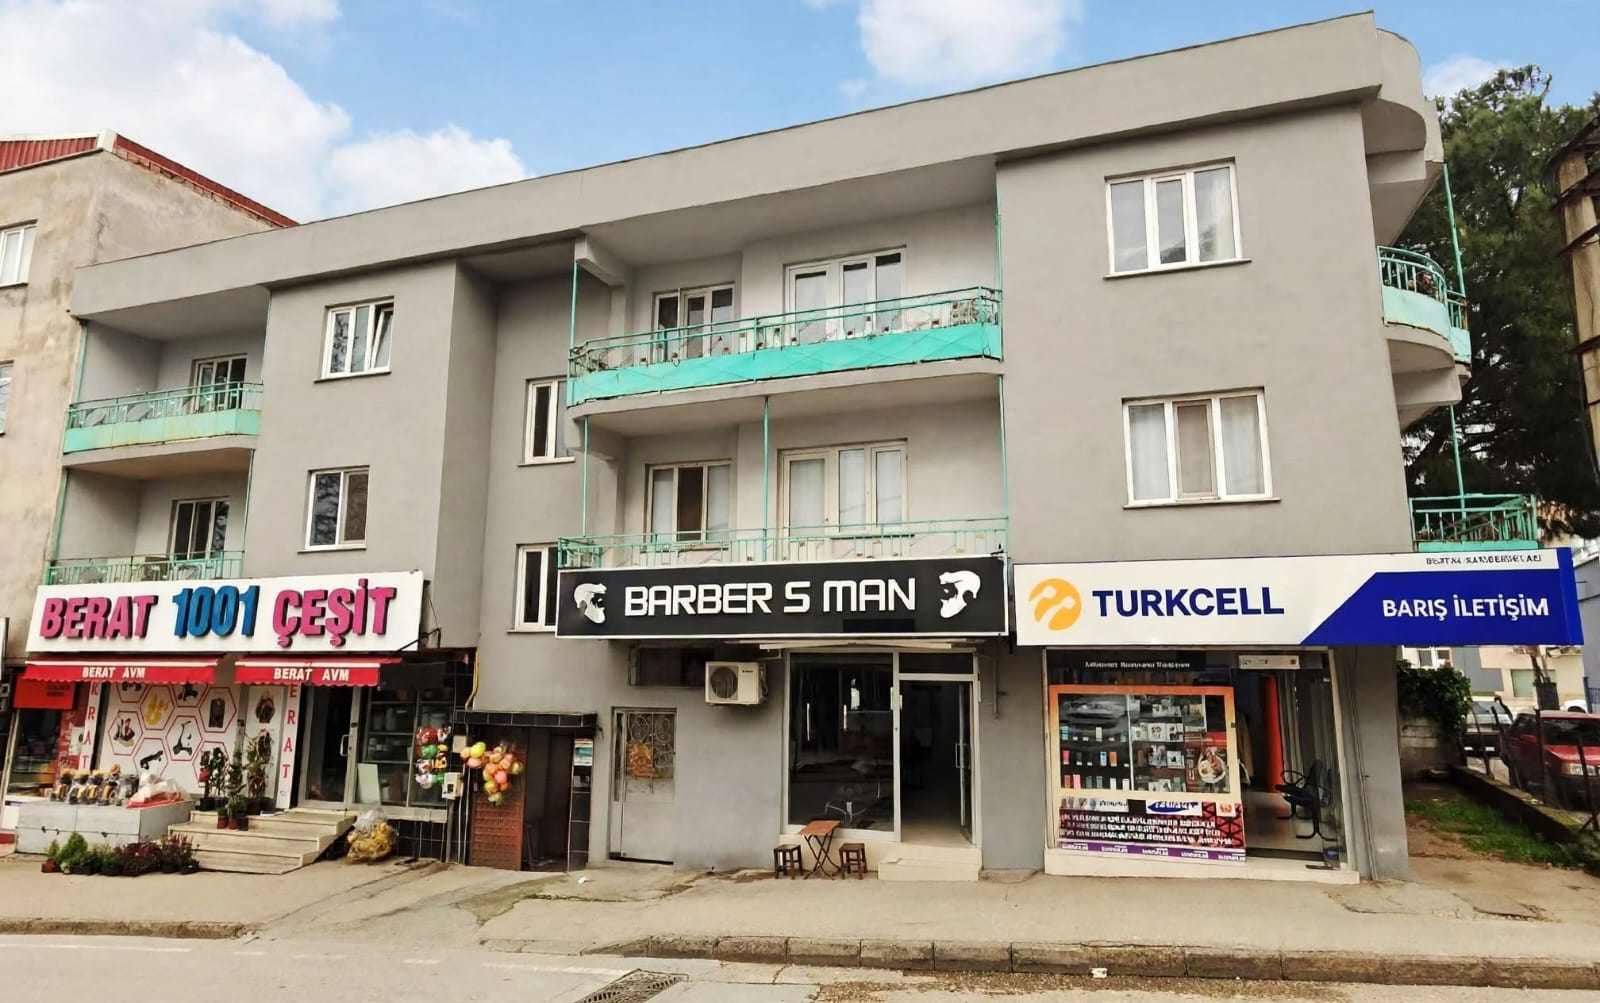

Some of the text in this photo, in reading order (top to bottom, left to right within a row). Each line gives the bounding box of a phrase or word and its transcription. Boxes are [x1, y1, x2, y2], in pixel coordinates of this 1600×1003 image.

[625, 578, 916, 616] BARBER S MAN
[1092, 586, 1285, 617] TURKCELL
[1382, 594, 1549, 621] BARIŞ İLETİŞİM
[40, 578, 397, 648] BERAT 1001 ÇEŞİT
[82, 667, 146, 678] BERAT AVM
[273, 668, 350, 681] BERAT AVM
